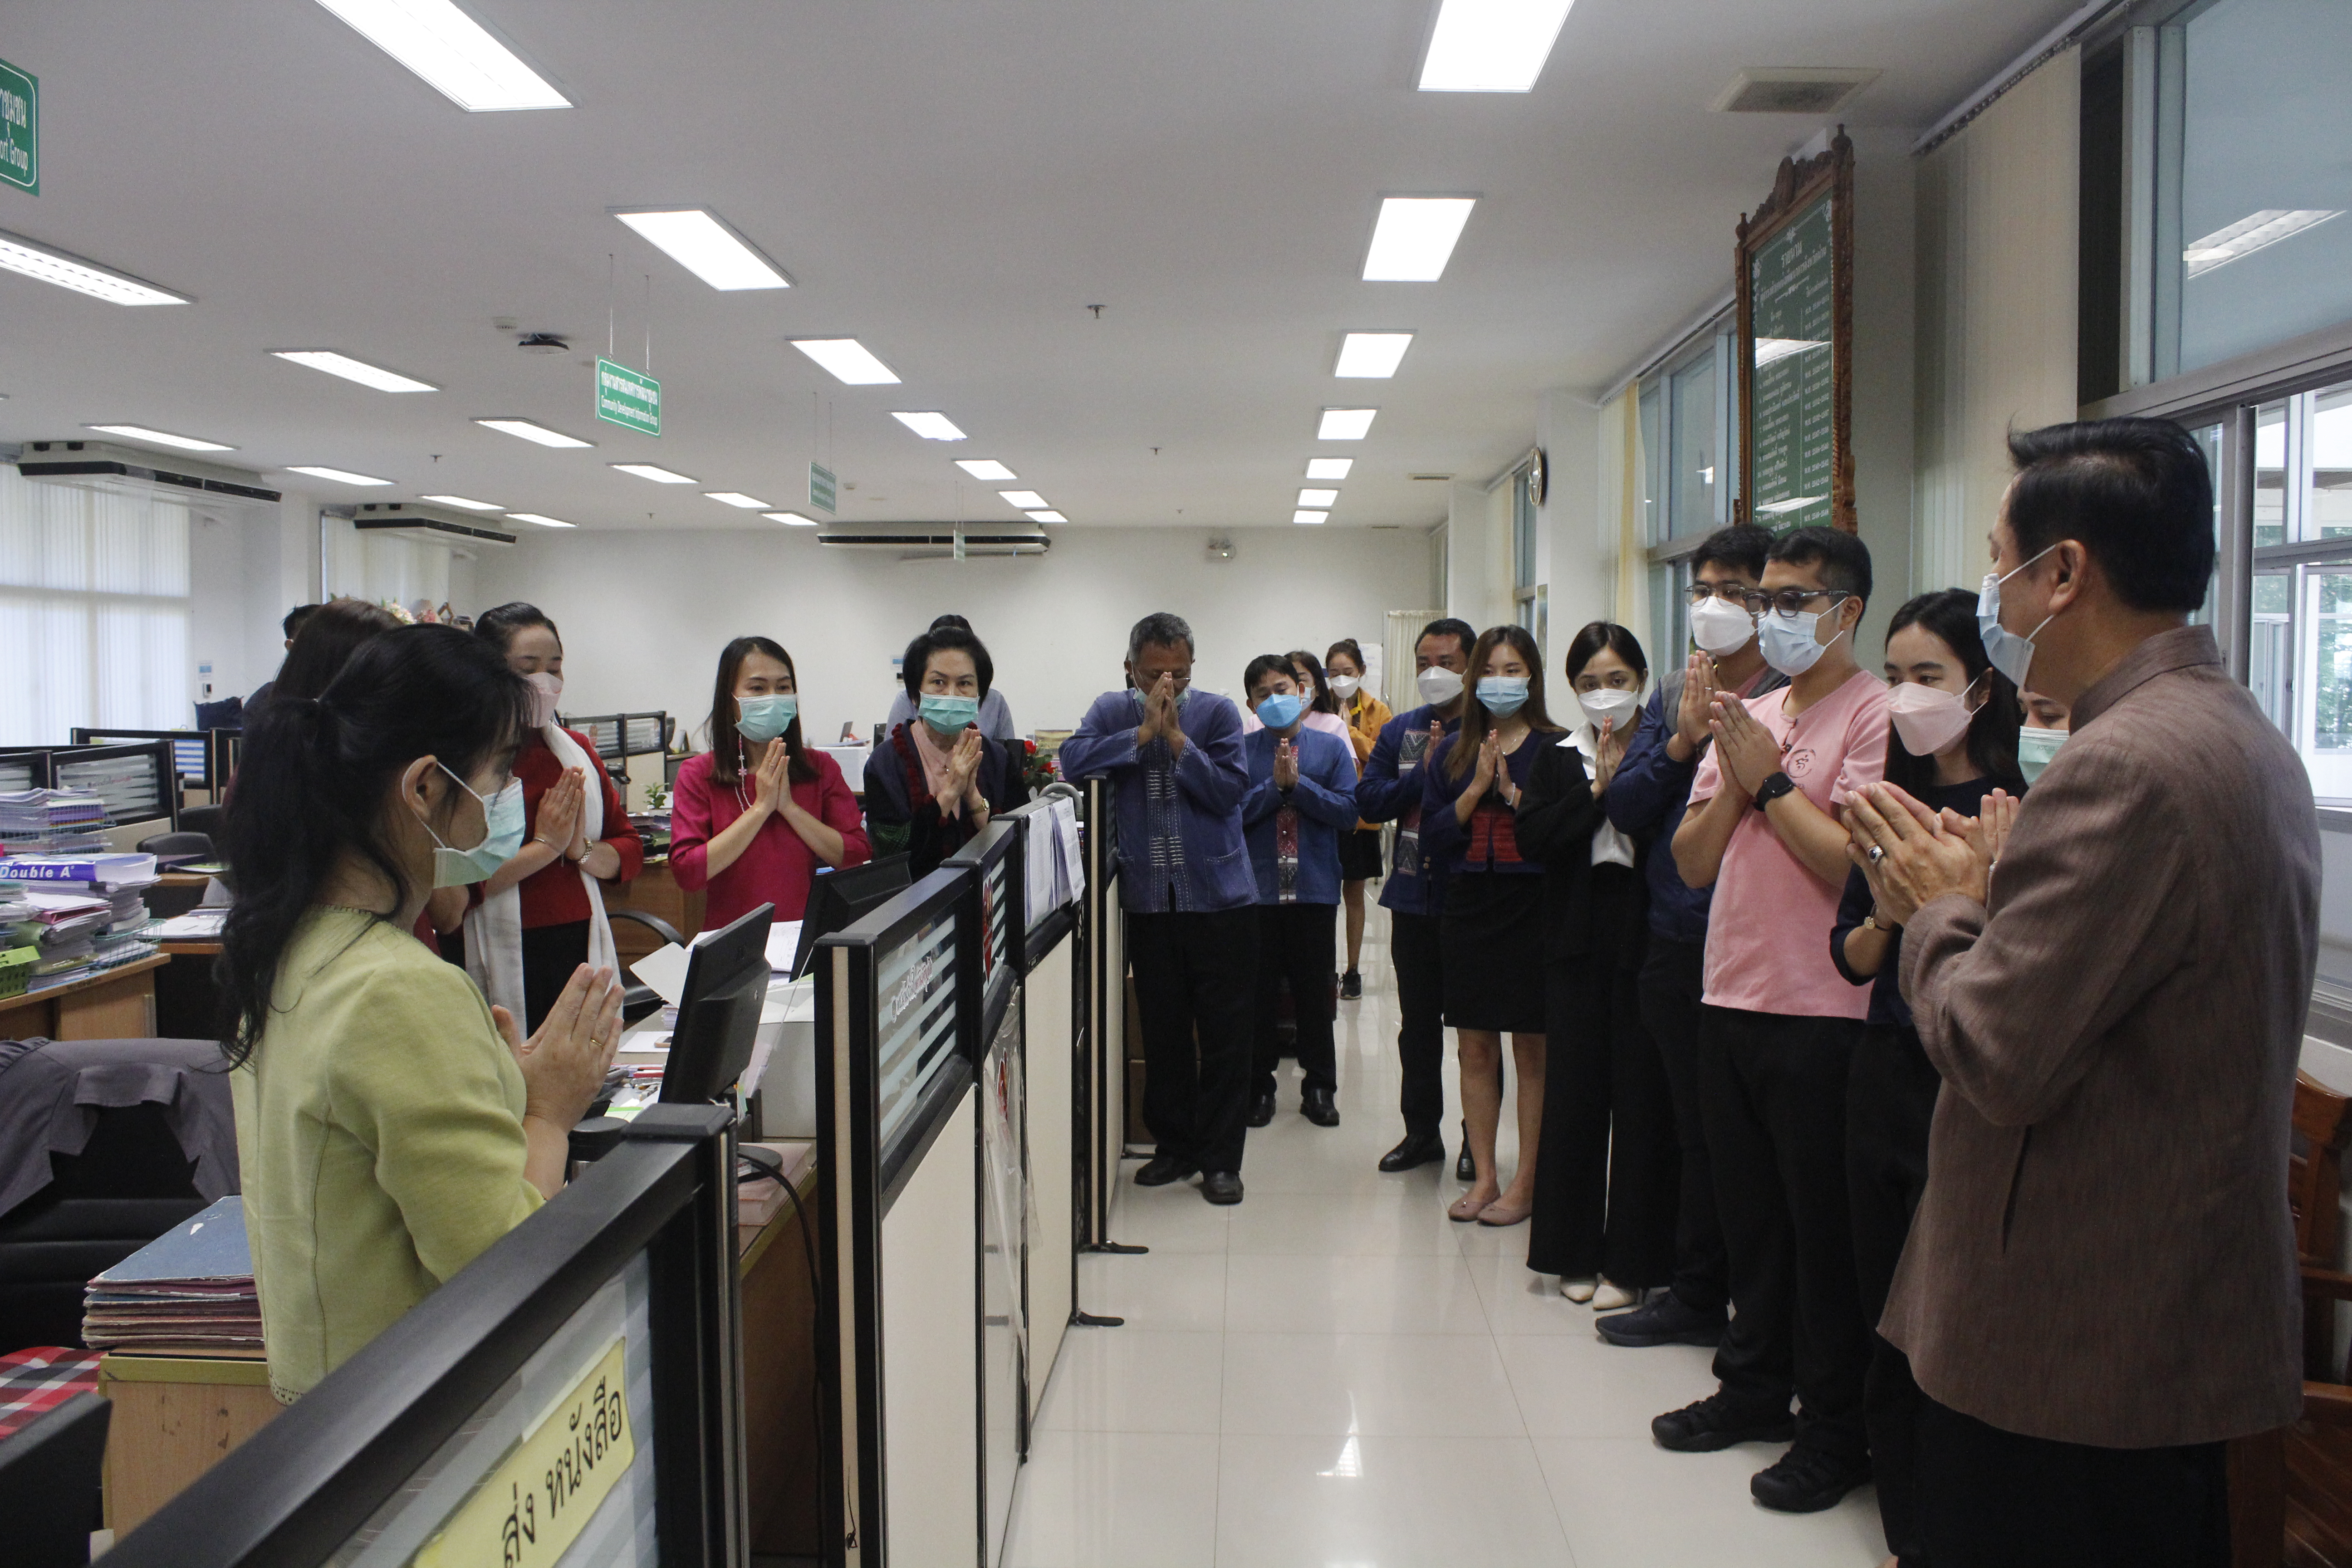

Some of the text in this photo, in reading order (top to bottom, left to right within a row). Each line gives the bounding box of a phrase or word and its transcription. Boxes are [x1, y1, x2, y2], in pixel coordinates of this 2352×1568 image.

[10, 138, 28, 177] Group
[0, 866, 54, 878] Double
[502, 1374, 622, 1568] ส่ง หนังสือ
